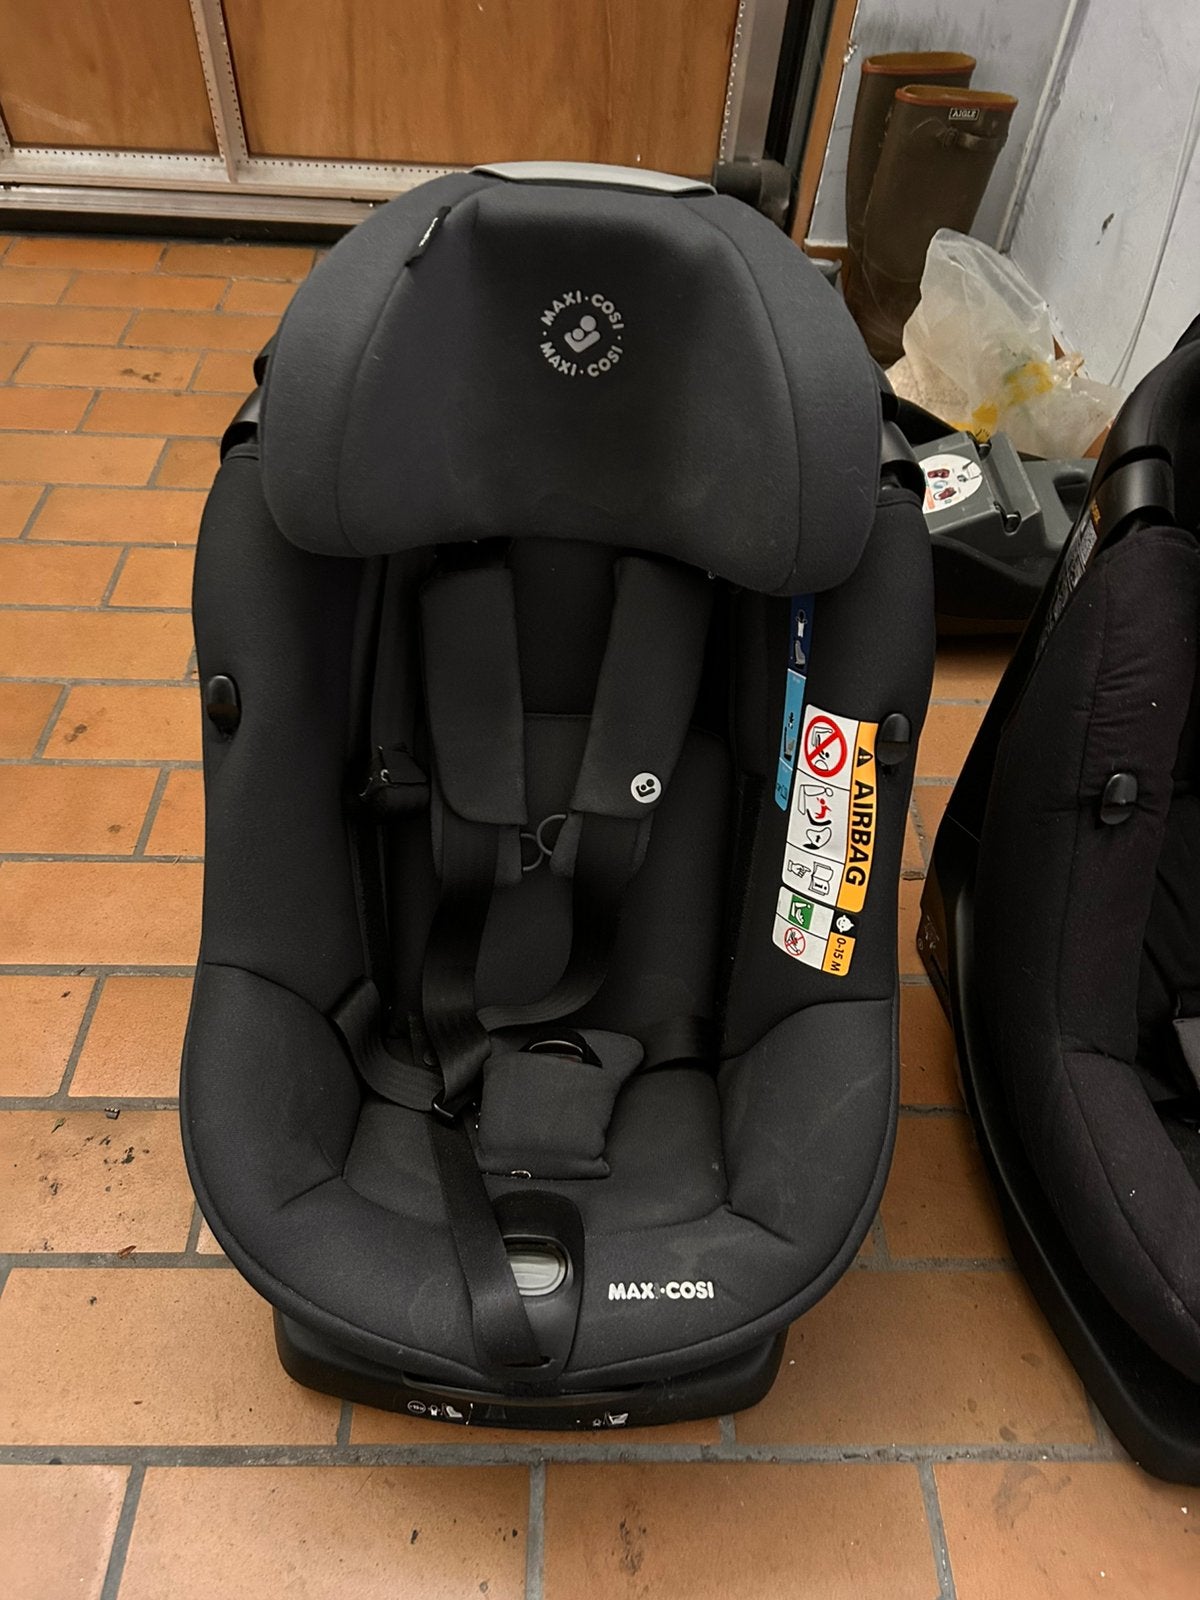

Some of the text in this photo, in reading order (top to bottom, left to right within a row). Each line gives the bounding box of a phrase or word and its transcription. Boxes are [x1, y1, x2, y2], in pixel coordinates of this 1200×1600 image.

[952, 109, 977, 118] AIGLE
[845, 779, 875, 887] AIRBAG
[830, 937, 847, 972] 0-15 M
